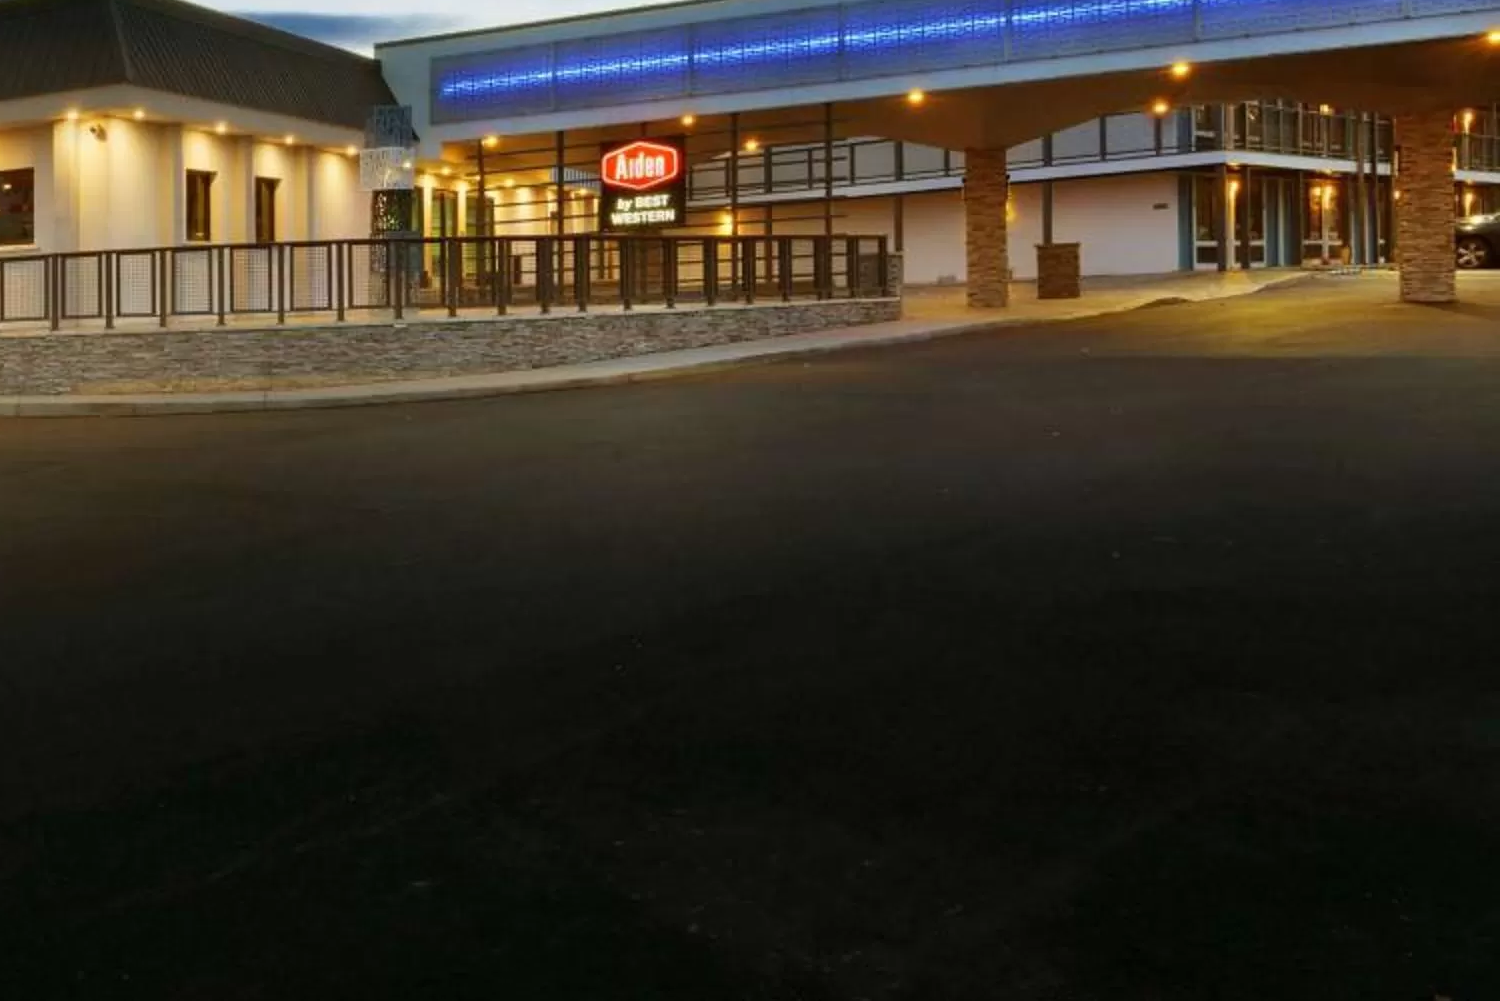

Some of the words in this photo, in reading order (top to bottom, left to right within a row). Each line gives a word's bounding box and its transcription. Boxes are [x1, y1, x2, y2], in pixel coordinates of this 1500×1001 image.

[615, 151, 665, 181] Aiden
[616, 198, 633, 211] by
[635, 194, 669, 208] BEST
[610, 209, 675, 225] WESTERN
